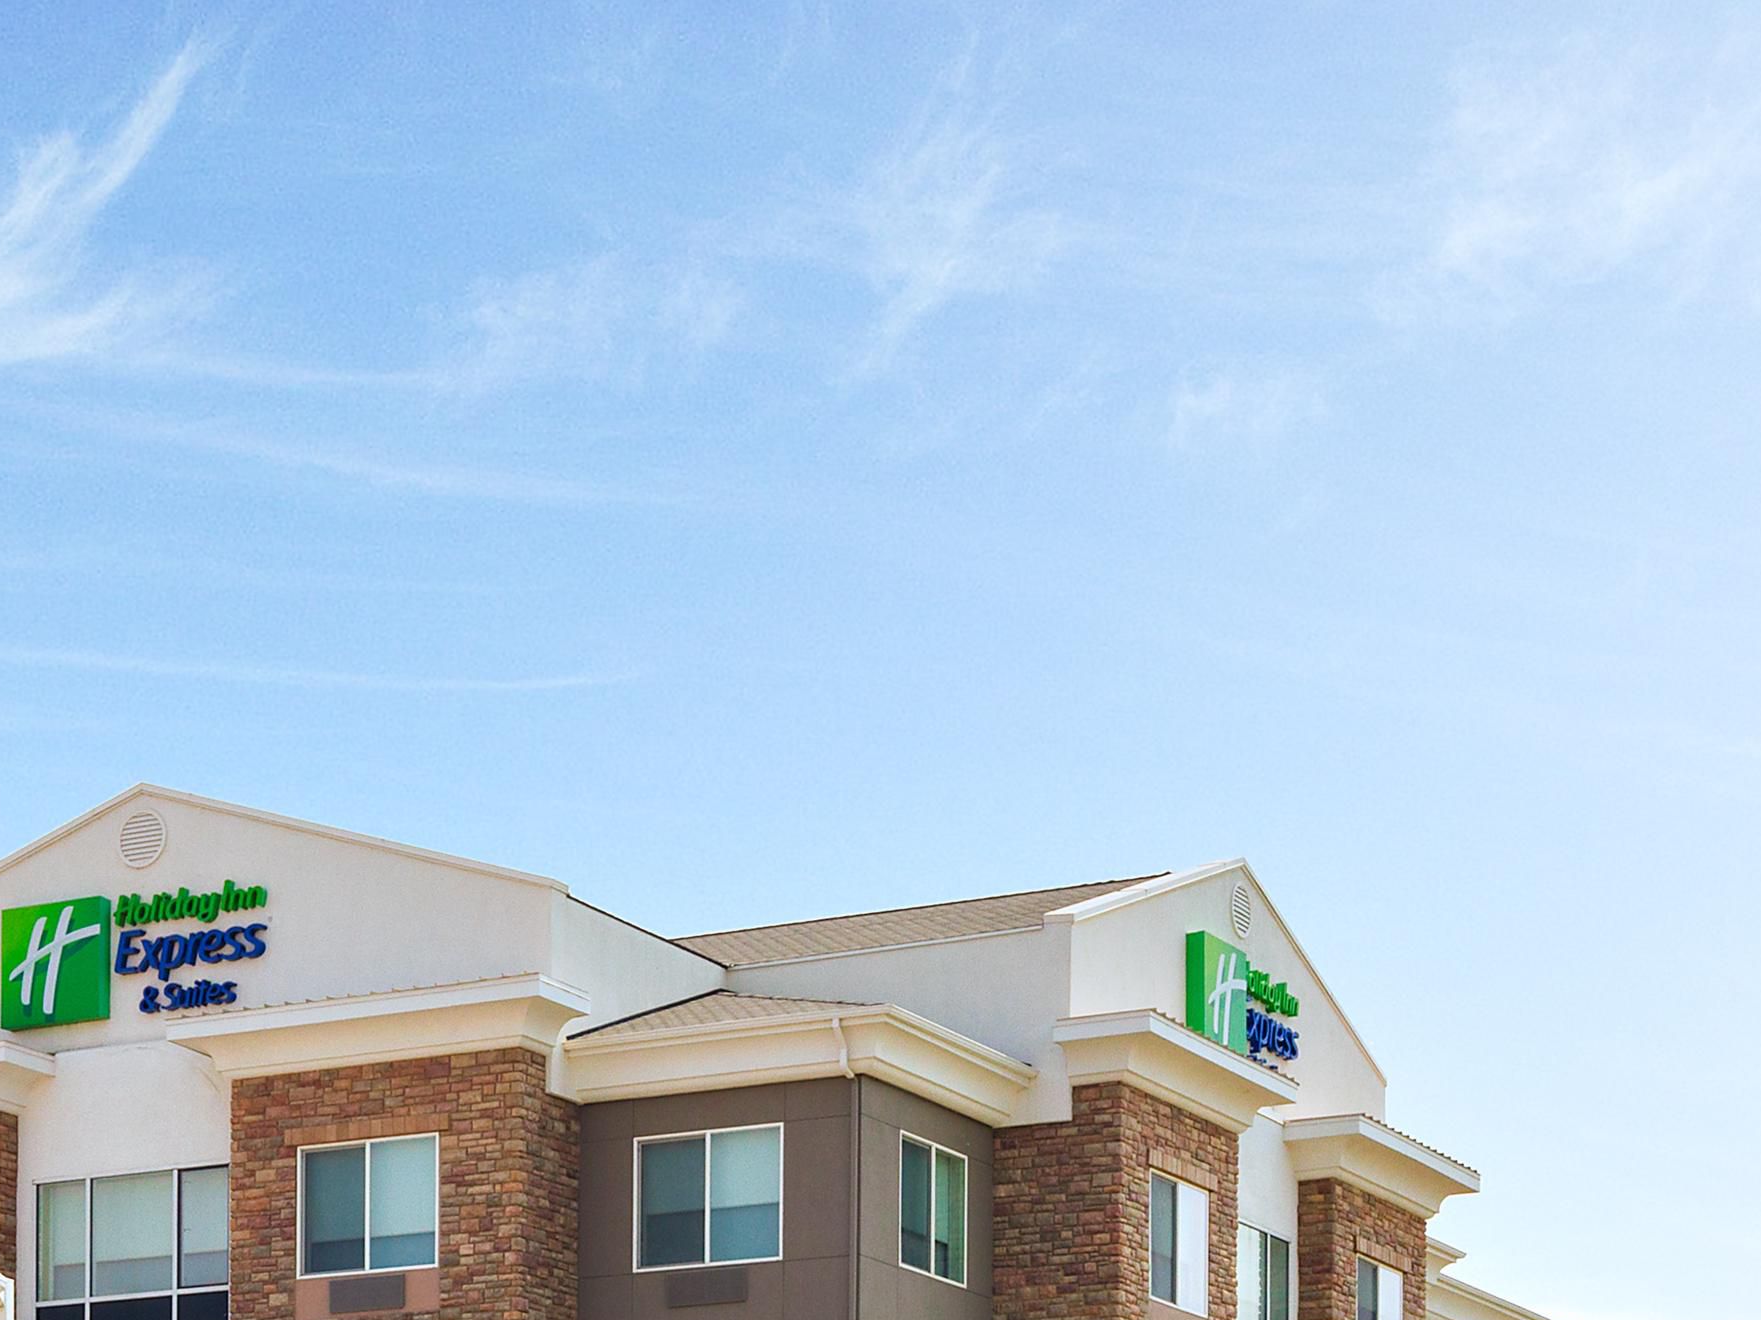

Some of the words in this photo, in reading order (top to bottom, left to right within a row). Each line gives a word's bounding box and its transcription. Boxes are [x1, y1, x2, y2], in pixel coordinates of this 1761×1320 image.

[114, 887, 222, 928] Holiday
[220, 879, 268, 913] Inn
[114, 923, 268, 982] Express
[139, 986, 161, 1014] &
[161, 979, 238, 1011] Suites
[1246, 961, 1281, 1014] oliday
[1246, 996, 1299, 1061] xpress
